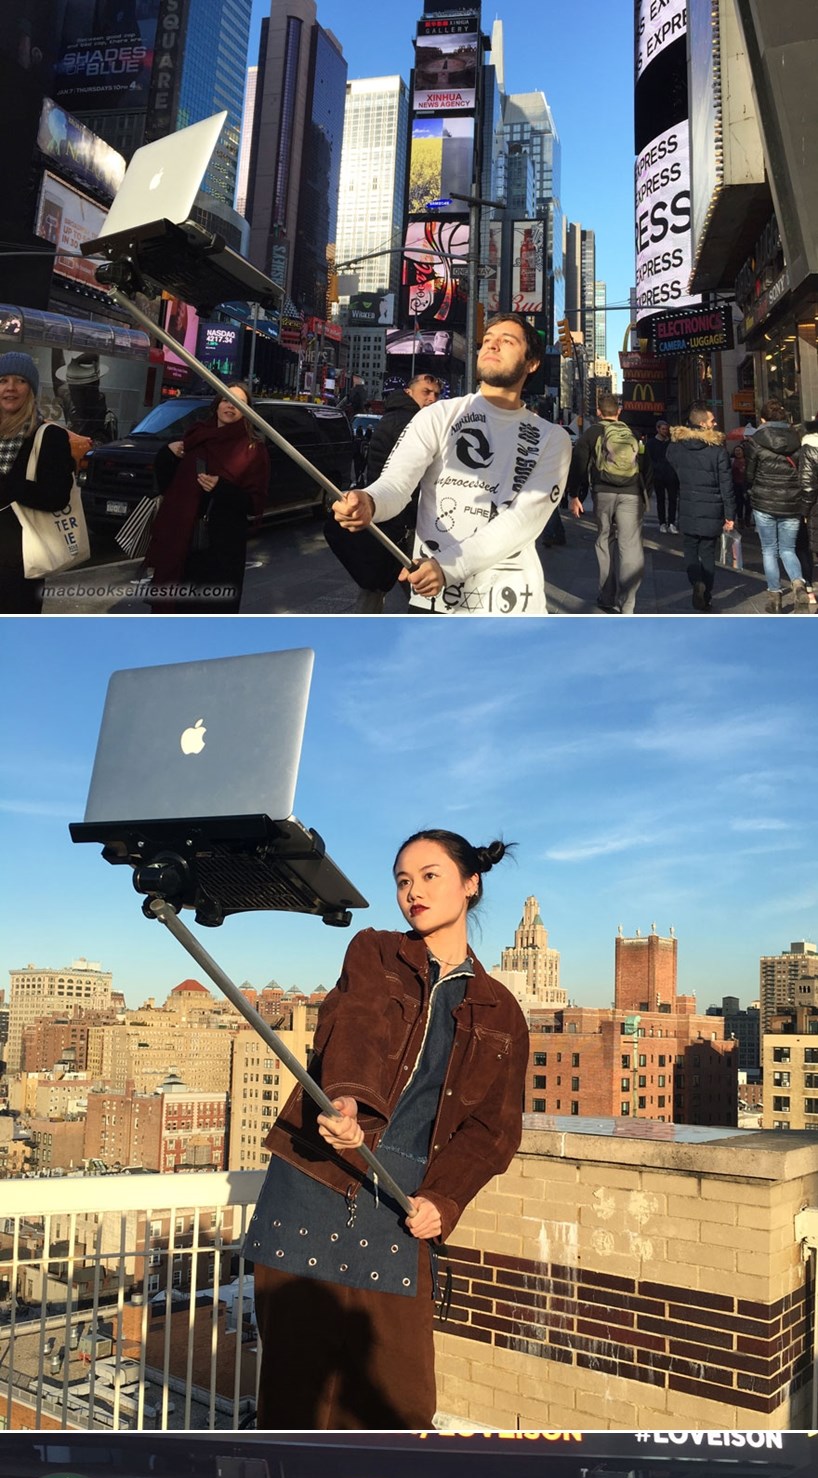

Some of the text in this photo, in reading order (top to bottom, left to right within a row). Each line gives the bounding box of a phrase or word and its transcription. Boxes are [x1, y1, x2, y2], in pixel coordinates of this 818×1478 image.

[426, 26, 469, 34] GALLERY
[63, 46, 147, 66] SHADES
[86, 60, 140, 76] BLUE
[427, 93, 462, 102] XINHUA
[441, 100, 470, 108] AGENCY
[657, 313, 723, 338] ELECTRONICS
[206, 330, 236, 339] NASDAQ
[660, 334, 724, 352] CAMERA LUGGAGE
[464, 505, 489, 518] PURE
[54, 516, 78, 532] TER
